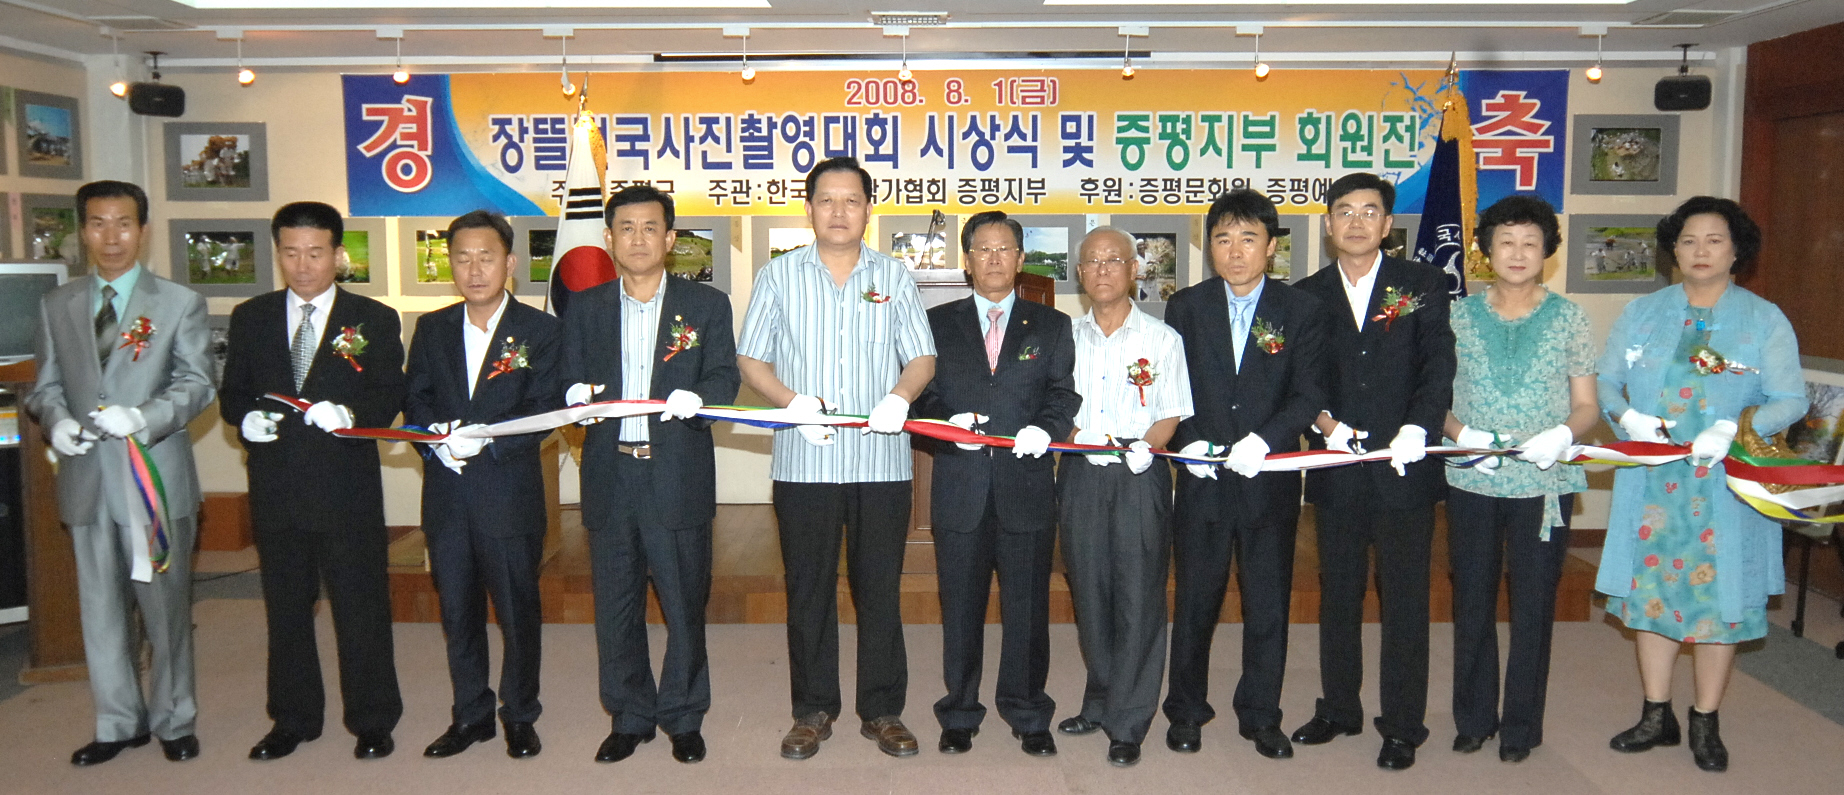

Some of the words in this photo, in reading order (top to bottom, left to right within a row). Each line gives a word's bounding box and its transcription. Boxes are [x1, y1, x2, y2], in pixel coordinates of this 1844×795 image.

[846, 80, 924, 106] 2008.
[946, 80, 969, 106] 8.
[993, 79, 1058, 106] 1(금)
[359, 96, 431, 191] 경
[493, 113, 900, 173] 장뜰국사진촬영대회
[920, 114, 1039, 172] 시상식
[1060, 114, 1094, 169] 및
[1116, 113, 1277, 171] 증평지부
[1297, 112, 1418, 169] 회원전
[1475, 93, 1553, 188] 축
[708, 178, 946, 205] 주관:한국가협회
[957, 178, 1047, 205] 증평지부
